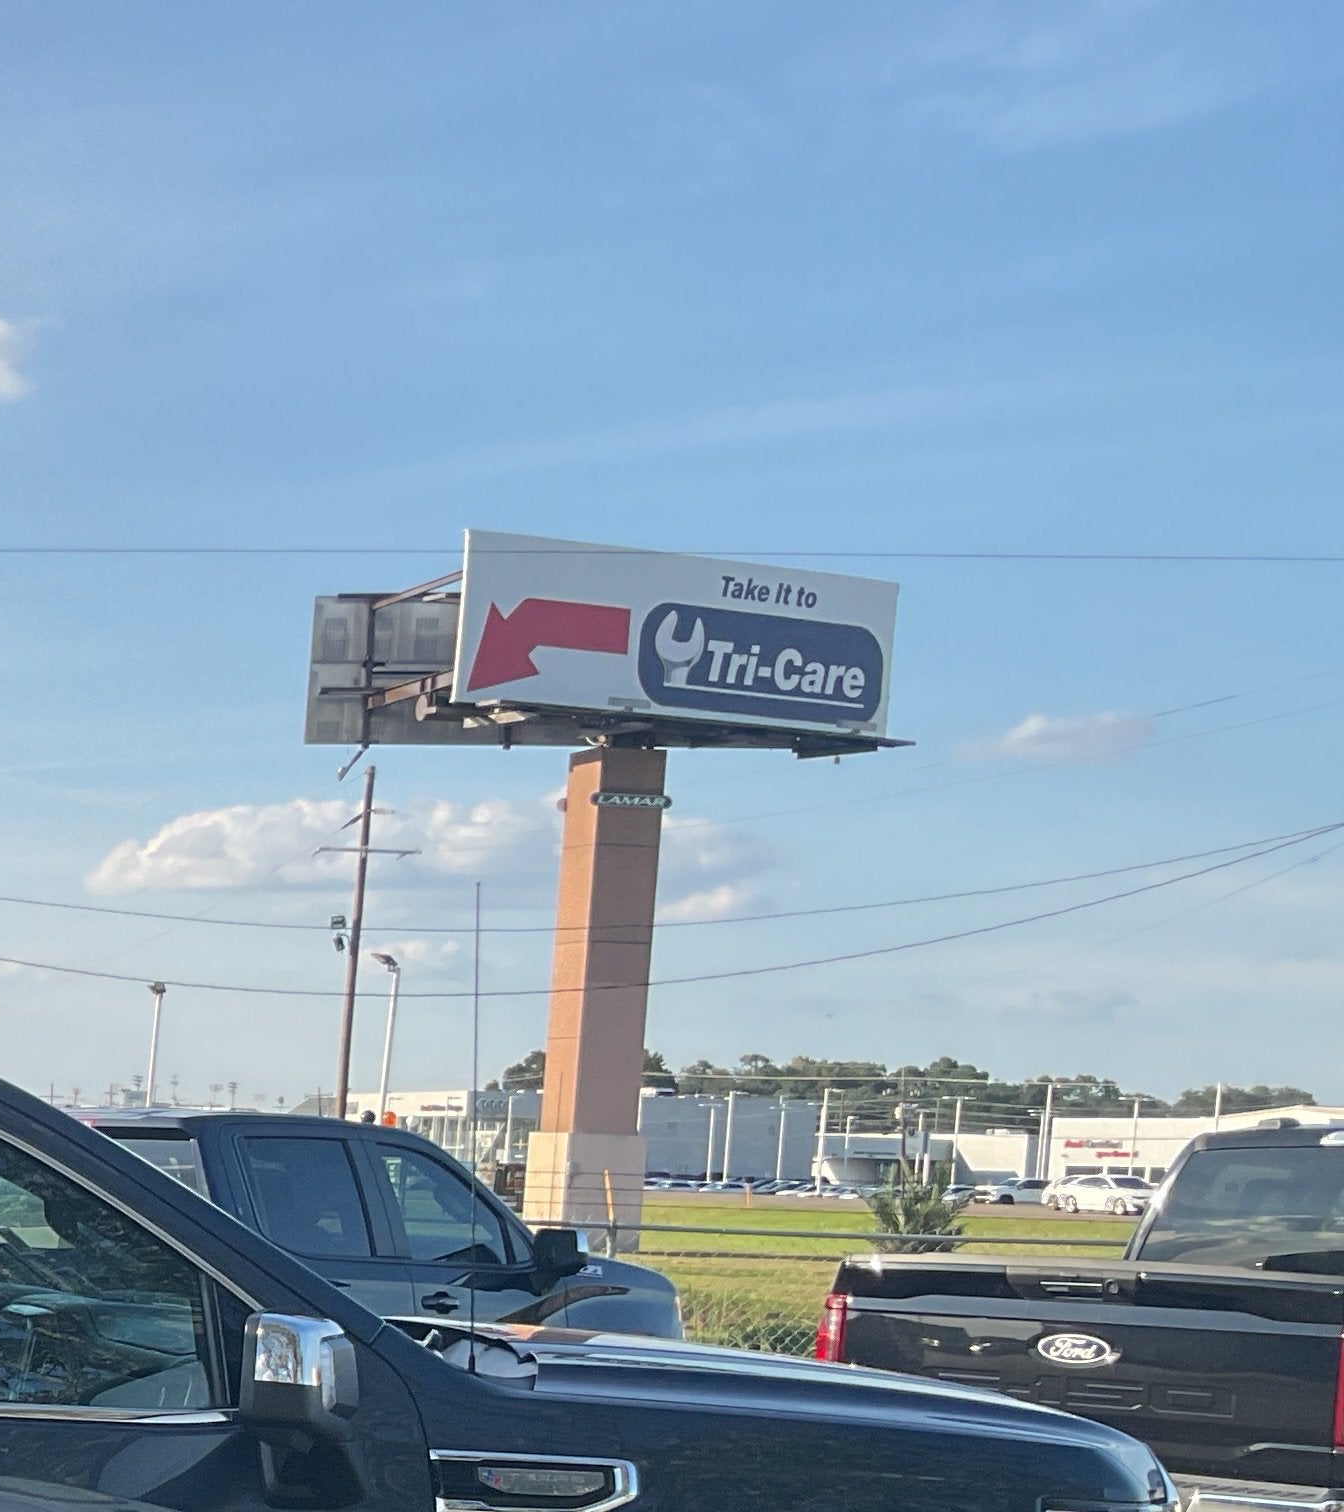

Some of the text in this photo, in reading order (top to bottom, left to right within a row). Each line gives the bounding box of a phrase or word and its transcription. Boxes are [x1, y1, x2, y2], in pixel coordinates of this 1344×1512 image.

[722, 576, 817, 609] Take It to
[707, 640, 866, 698] Tri-Care
[597, 795, 667, 807] LAMAR
[1049, 1338, 1096, 1361] Ford
